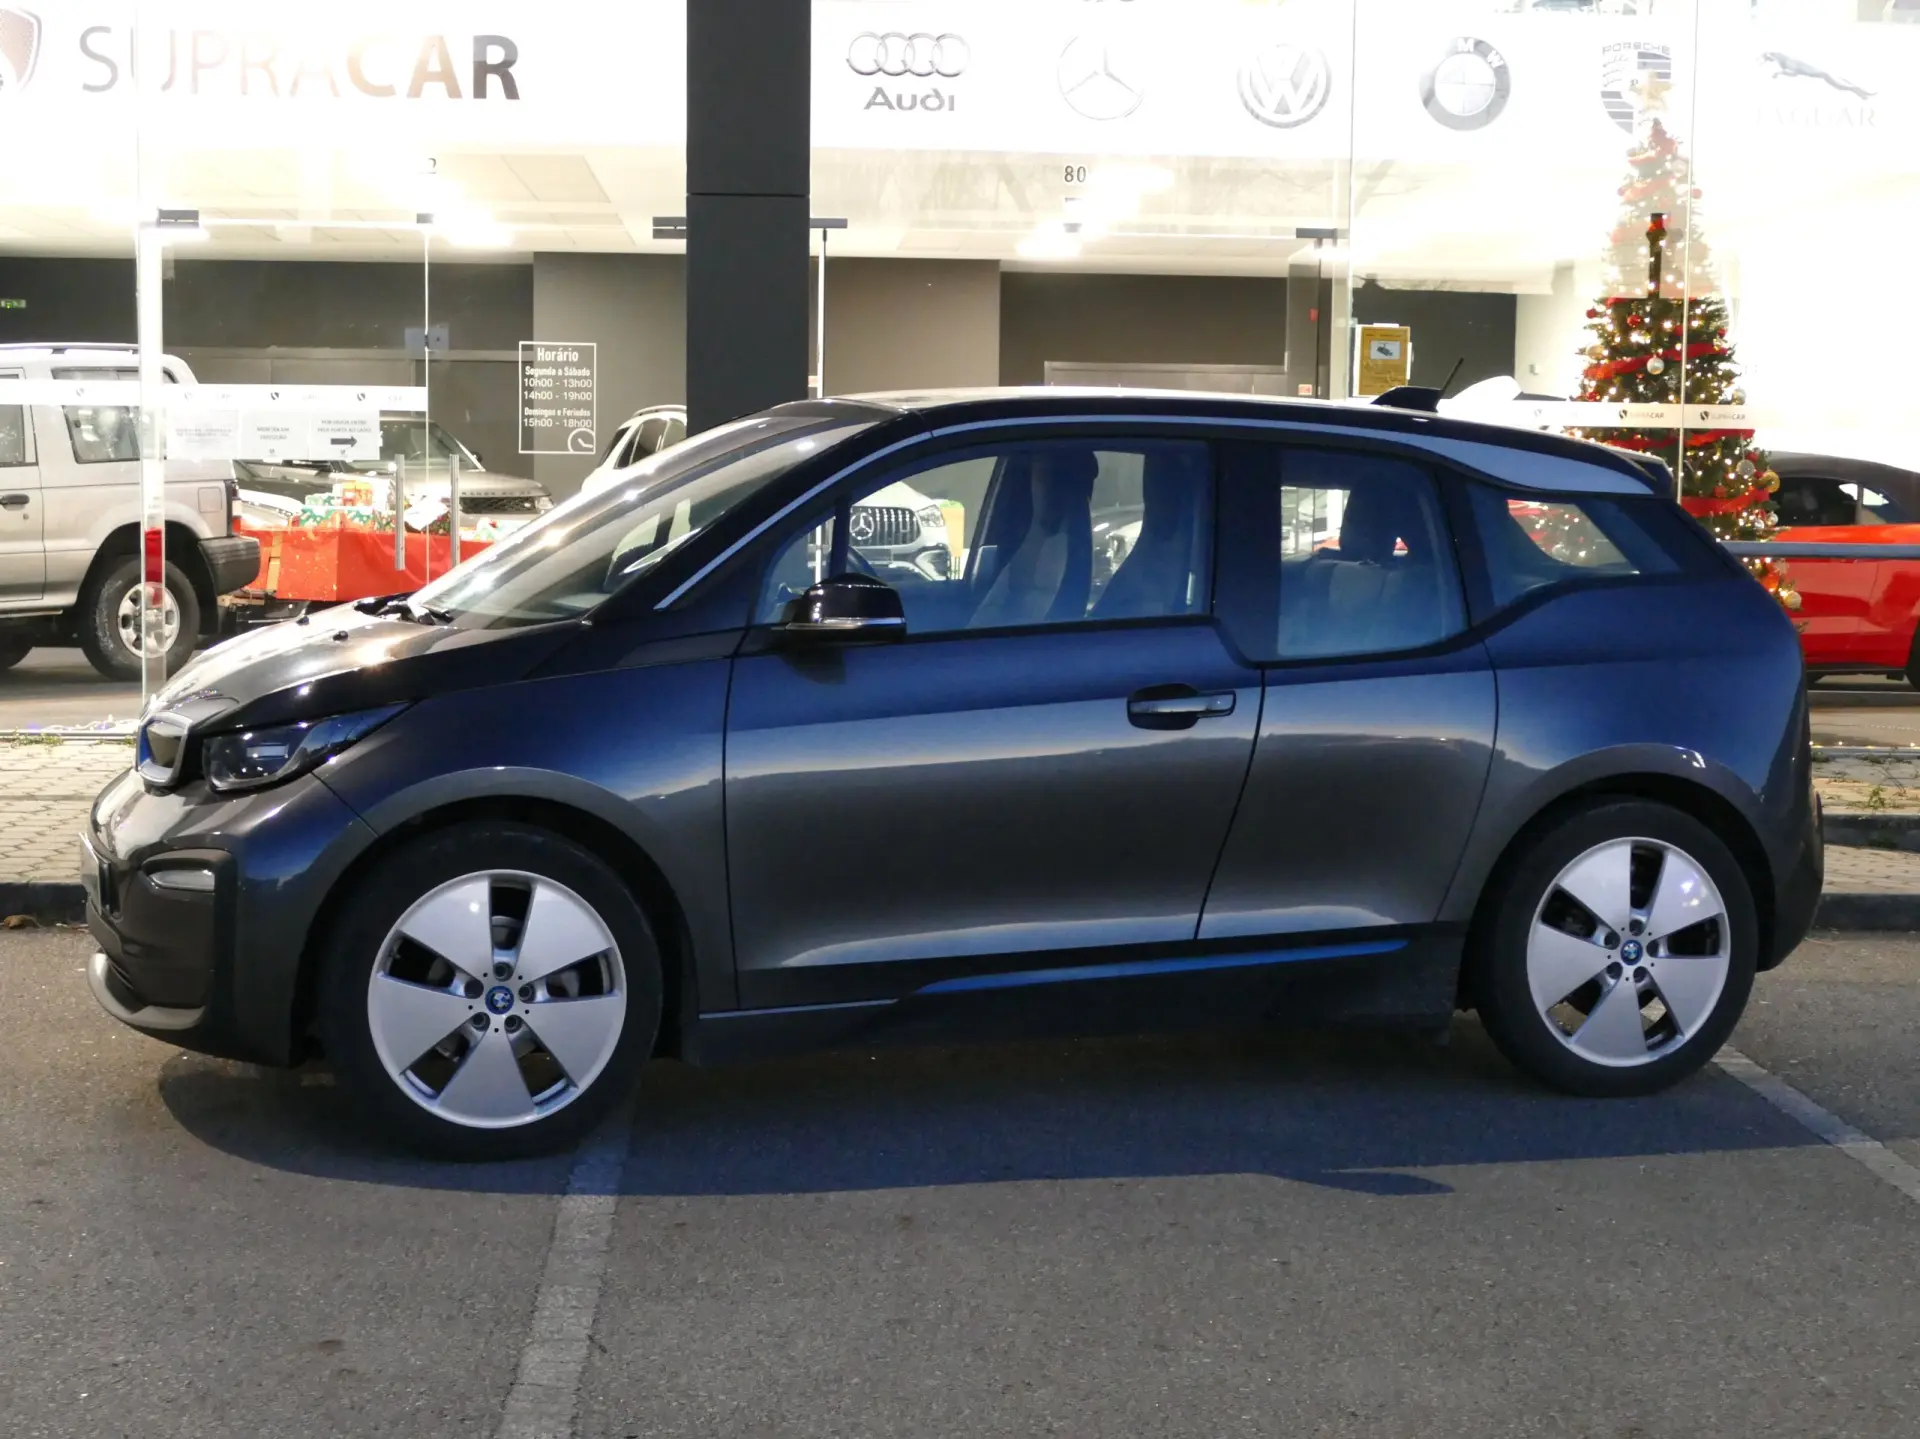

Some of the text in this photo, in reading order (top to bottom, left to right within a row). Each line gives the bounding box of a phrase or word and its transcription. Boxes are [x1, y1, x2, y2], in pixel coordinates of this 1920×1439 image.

[1602, 41, 1671, 56] PORSCHE
[79, 25, 521, 101] SUPRACAR
[863, 86, 955, 112] Audi
[1064, 165, 1087, 183] 80
[537, 347, 579, 362] Horário
[525, 366, 556, 378] Segunda
[563, 366, 591, 377] Sábado
[523, 378, 553, 388] 10h00
[563, 378, 593, 388] 13h00
[523, 391, 553, 401] 14h00
[563, 391, 593, 401] 19h00
[523, 418, 553, 428] 15h00
[563, 418, 593, 428] 18h00
